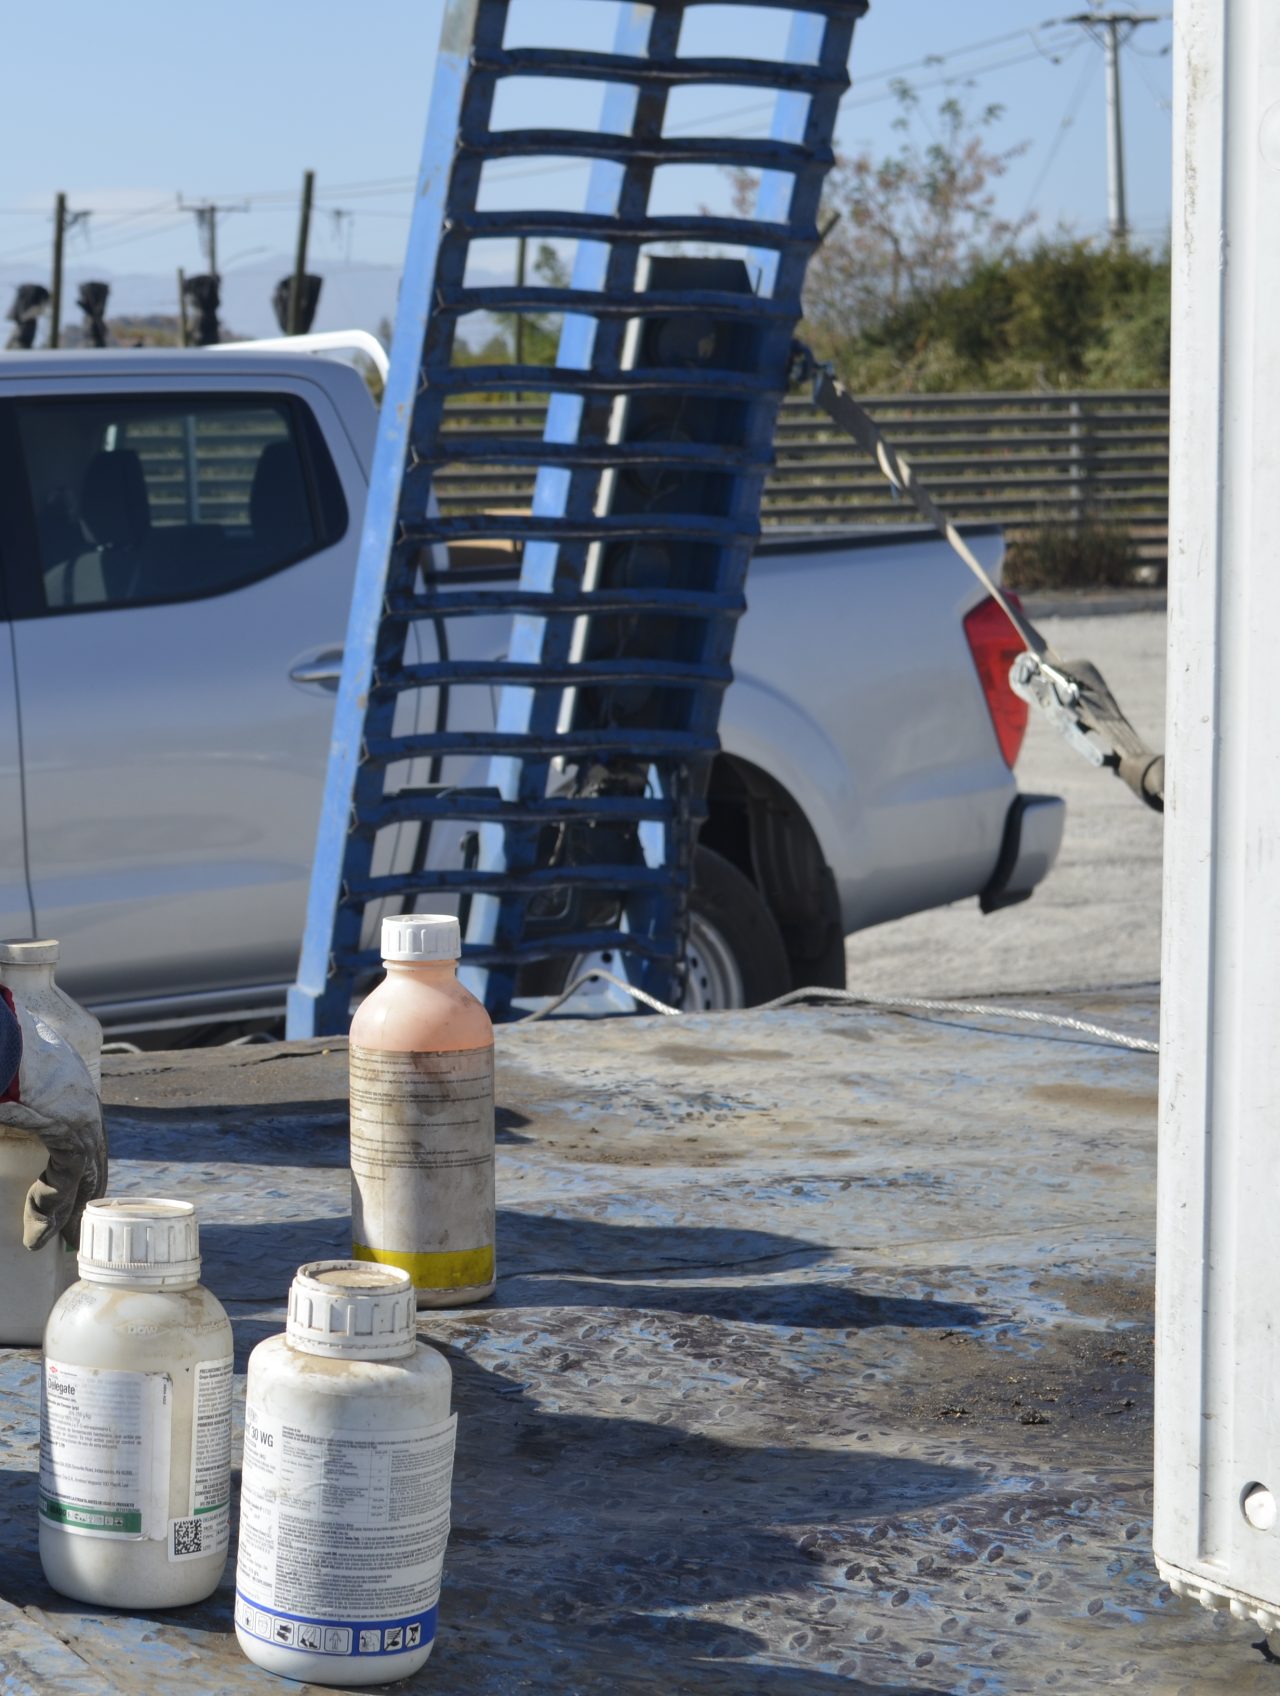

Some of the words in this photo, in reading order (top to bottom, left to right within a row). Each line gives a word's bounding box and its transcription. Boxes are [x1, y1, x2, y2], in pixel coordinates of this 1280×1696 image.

[47, 1376, 76, 1396] Delegate
[251, 1426, 259, 1441] 30
[260, 1430, 274, 1448] WG
